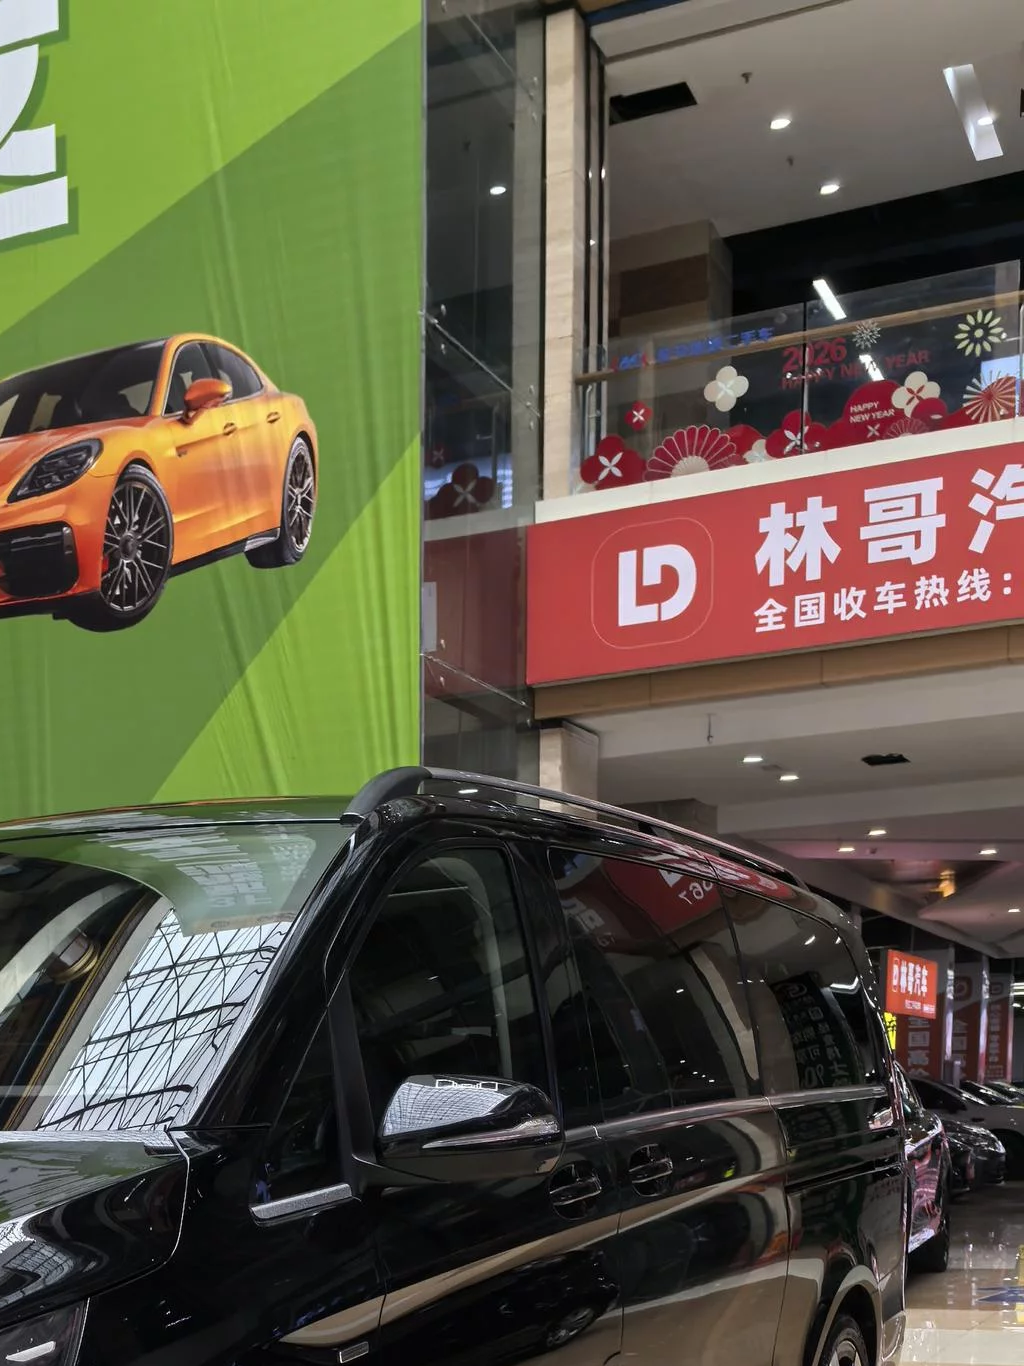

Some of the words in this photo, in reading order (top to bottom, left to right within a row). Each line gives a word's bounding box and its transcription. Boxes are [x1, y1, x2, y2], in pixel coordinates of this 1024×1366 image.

[781, 337, 848, 373] 2026
[885, 349, 932, 370] YEAR
[849, 401, 880, 414] HAPPY
[849, 413, 871, 424] NEW
[871, 408, 895, 421] YEAR
[755, 463, 1024, 587] 林哥汽
[754, 568, 1012, 633] 全国收车热线：
